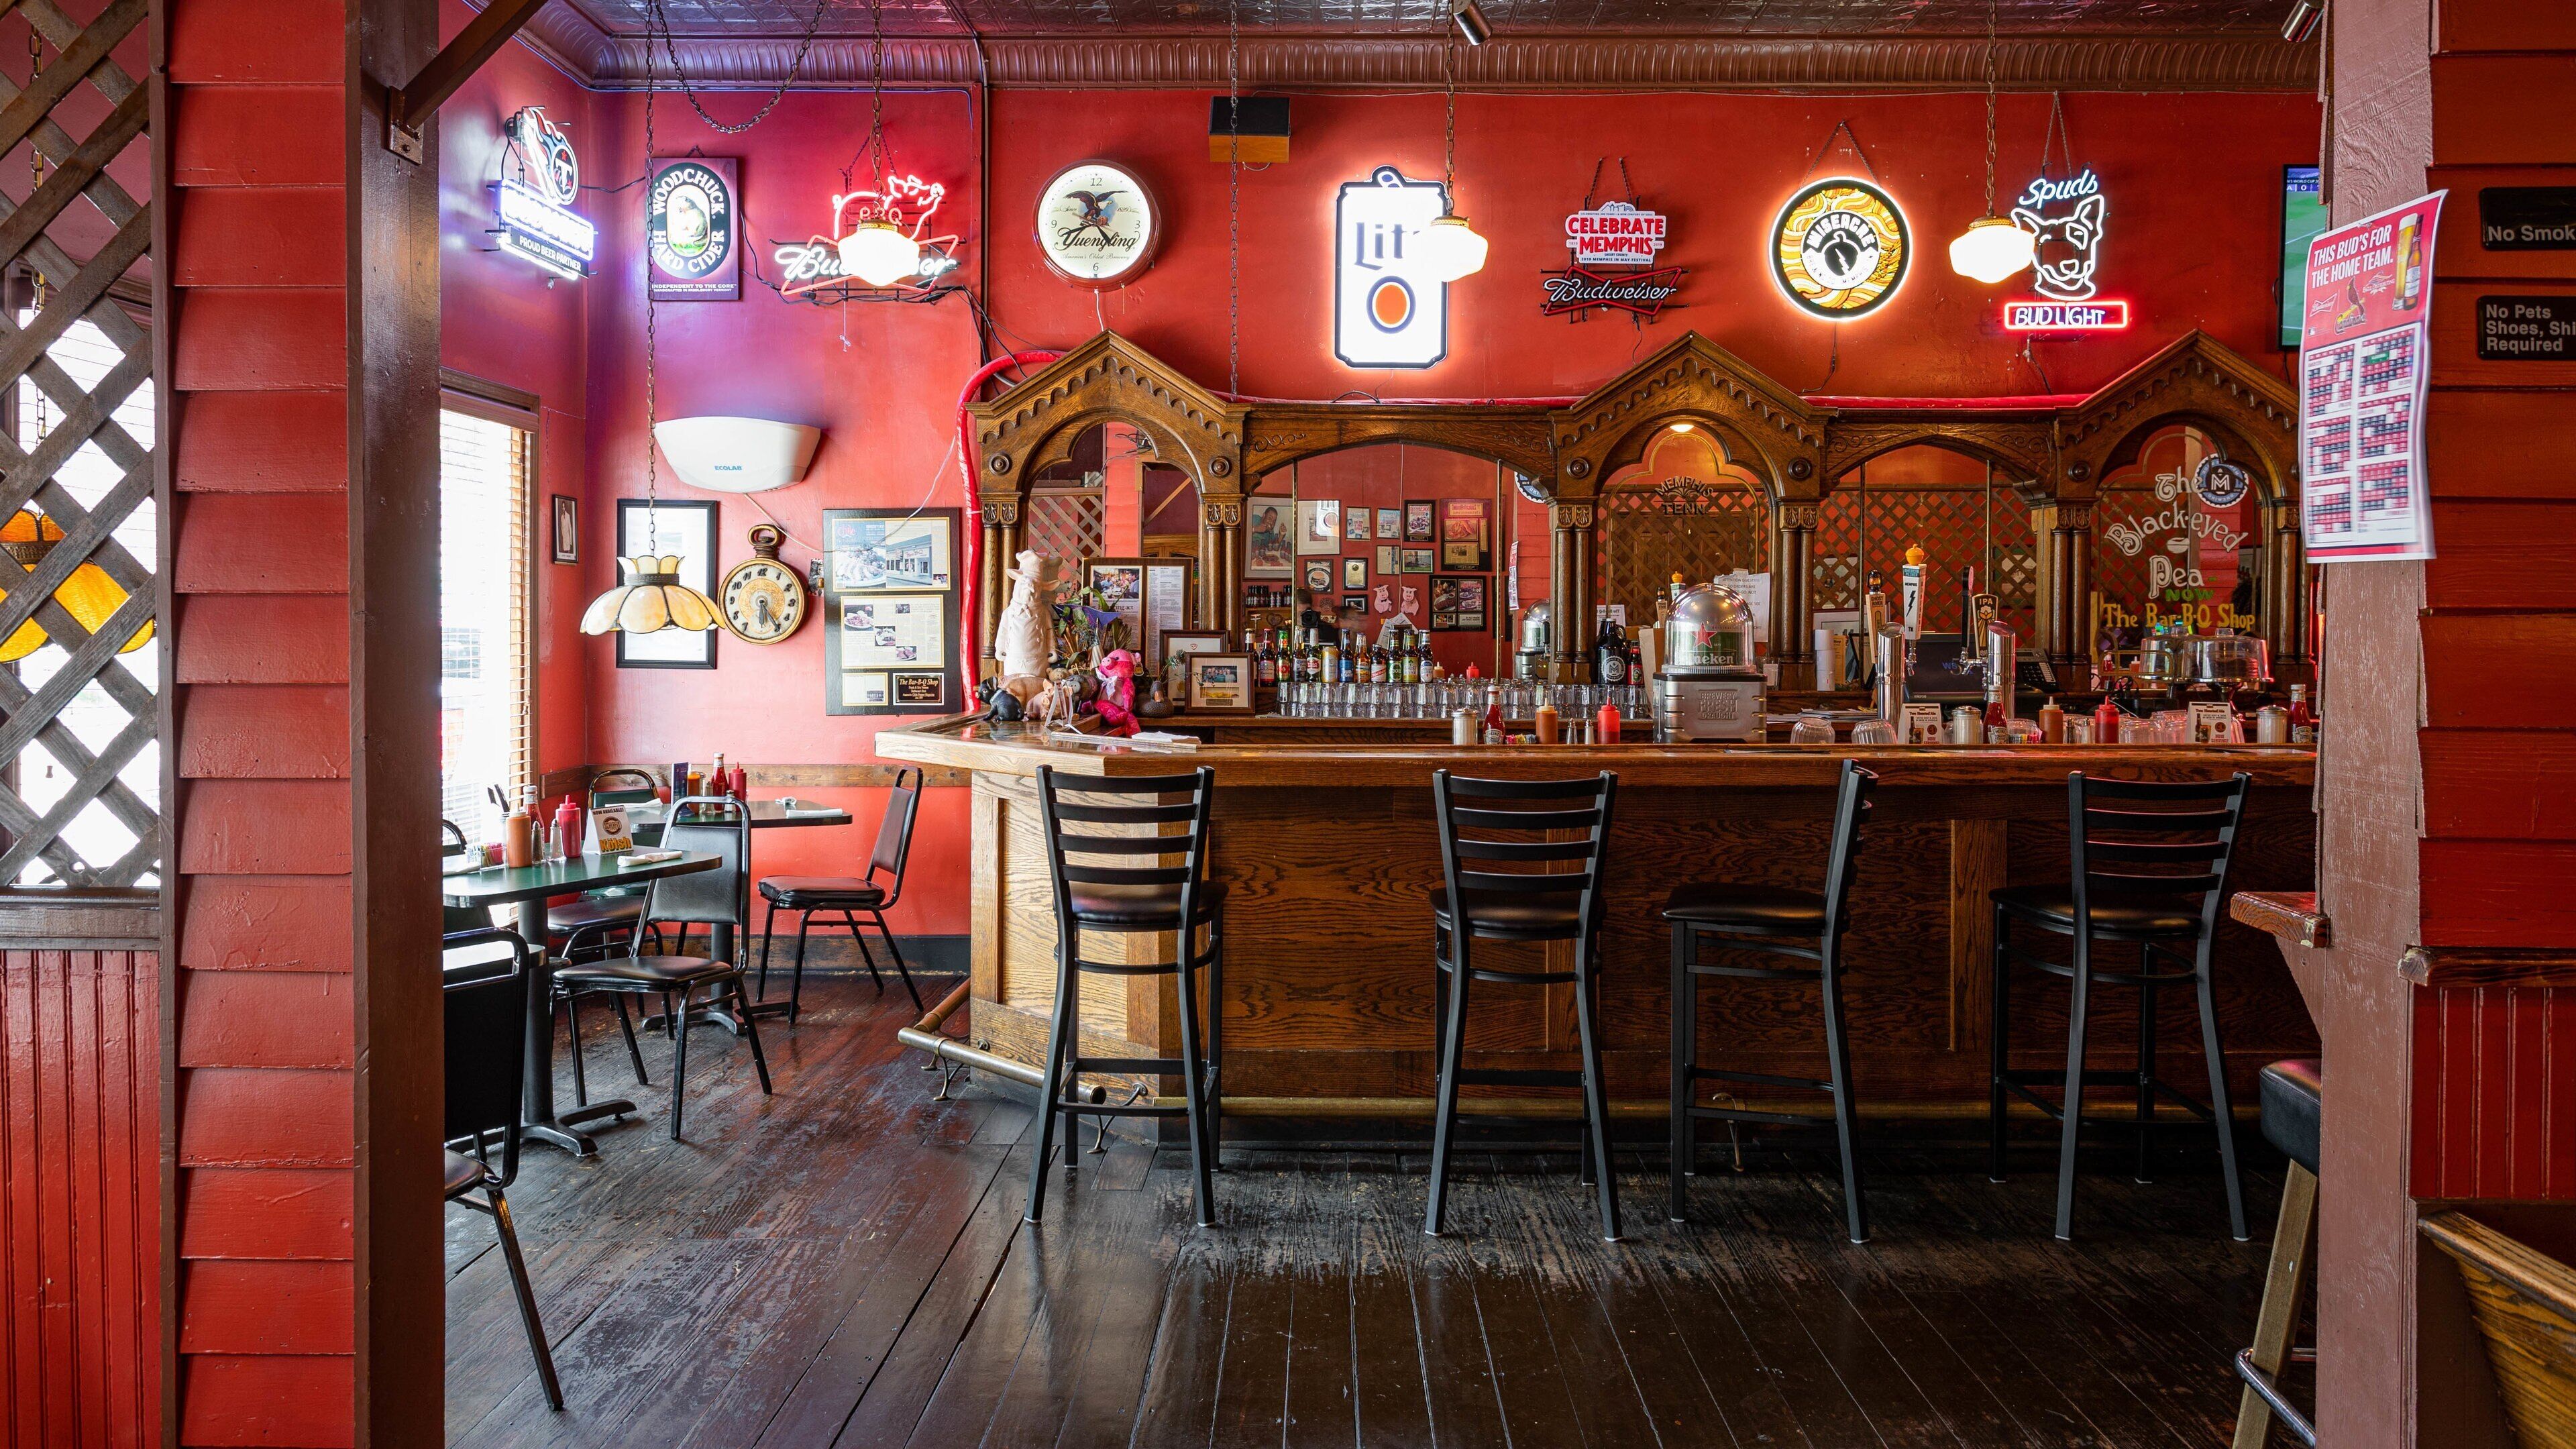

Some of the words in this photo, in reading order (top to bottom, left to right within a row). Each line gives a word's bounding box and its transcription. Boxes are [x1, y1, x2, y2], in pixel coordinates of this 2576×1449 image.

[1090, 177, 1103, 186] 12
[2019, 169, 2098, 209] Spuds
[653, 168, 725, 215] WOODCHUCK
[1051, 219, 1057, 229] 9
[1134, 220, 1140, 229] 3
[1568, 217, 1664, 234] CELEBRATE
[1807, 213, 1876, 249] WISEACRE
[2487, 225, 2516, 241] No
[1054, 227, 1140, 252] Yuengling
[1578, 235, 1654, 256] MEMPHIS
[2314, 244, 2337, 268] THIS
[2337, 233, 2368, 259] BUD'S
[2369, 224, 2392, 249] FOR
[519, 235, 541, 253] PROUD
[541, 245, 556, 260] BEER
[556, 252, 582, 272] PARTNER
[653, 230, 684, 271] HARD
[687, 230, 725, 273] CIDER
[1093, 262, 1099, 272] 6
[2311, 264, 2330, 289] THE
[2330, 254, 2361, 284] HOME
[2362, 245, 2394, 274] TEAM.
[1544, 278, 1677, 302] Budweiser
[2015, 307, 2053, 325] BUD
[2055, 307, 2106, 326] LIGHT
[2485, 304, 2509, 319] No
[2515, 305, 2552, 319] Pets
[2485, 320, 2544, 337] Shoes,
[2486, 337, 2563, 354] Required
[1654, 476, 1714, 497] MEMPHIS
[2155, 466, 2205, 502] The
[2149, 555, 2204, 600] Pea
[2165, 588, 2214, 602] NOW
[2104, 603, 2139, 628] The
[2216, 603, 2256, 631] Shop
[908, 678, 926, 686] Bar-B-Q
[926, 678, 938, 687] Shop
[1700, 699, 1737, 712] FRESH
[1701, 692, 1735, 700] BREWERY
[1702, 711, 1735, 720] DRAUGHT
